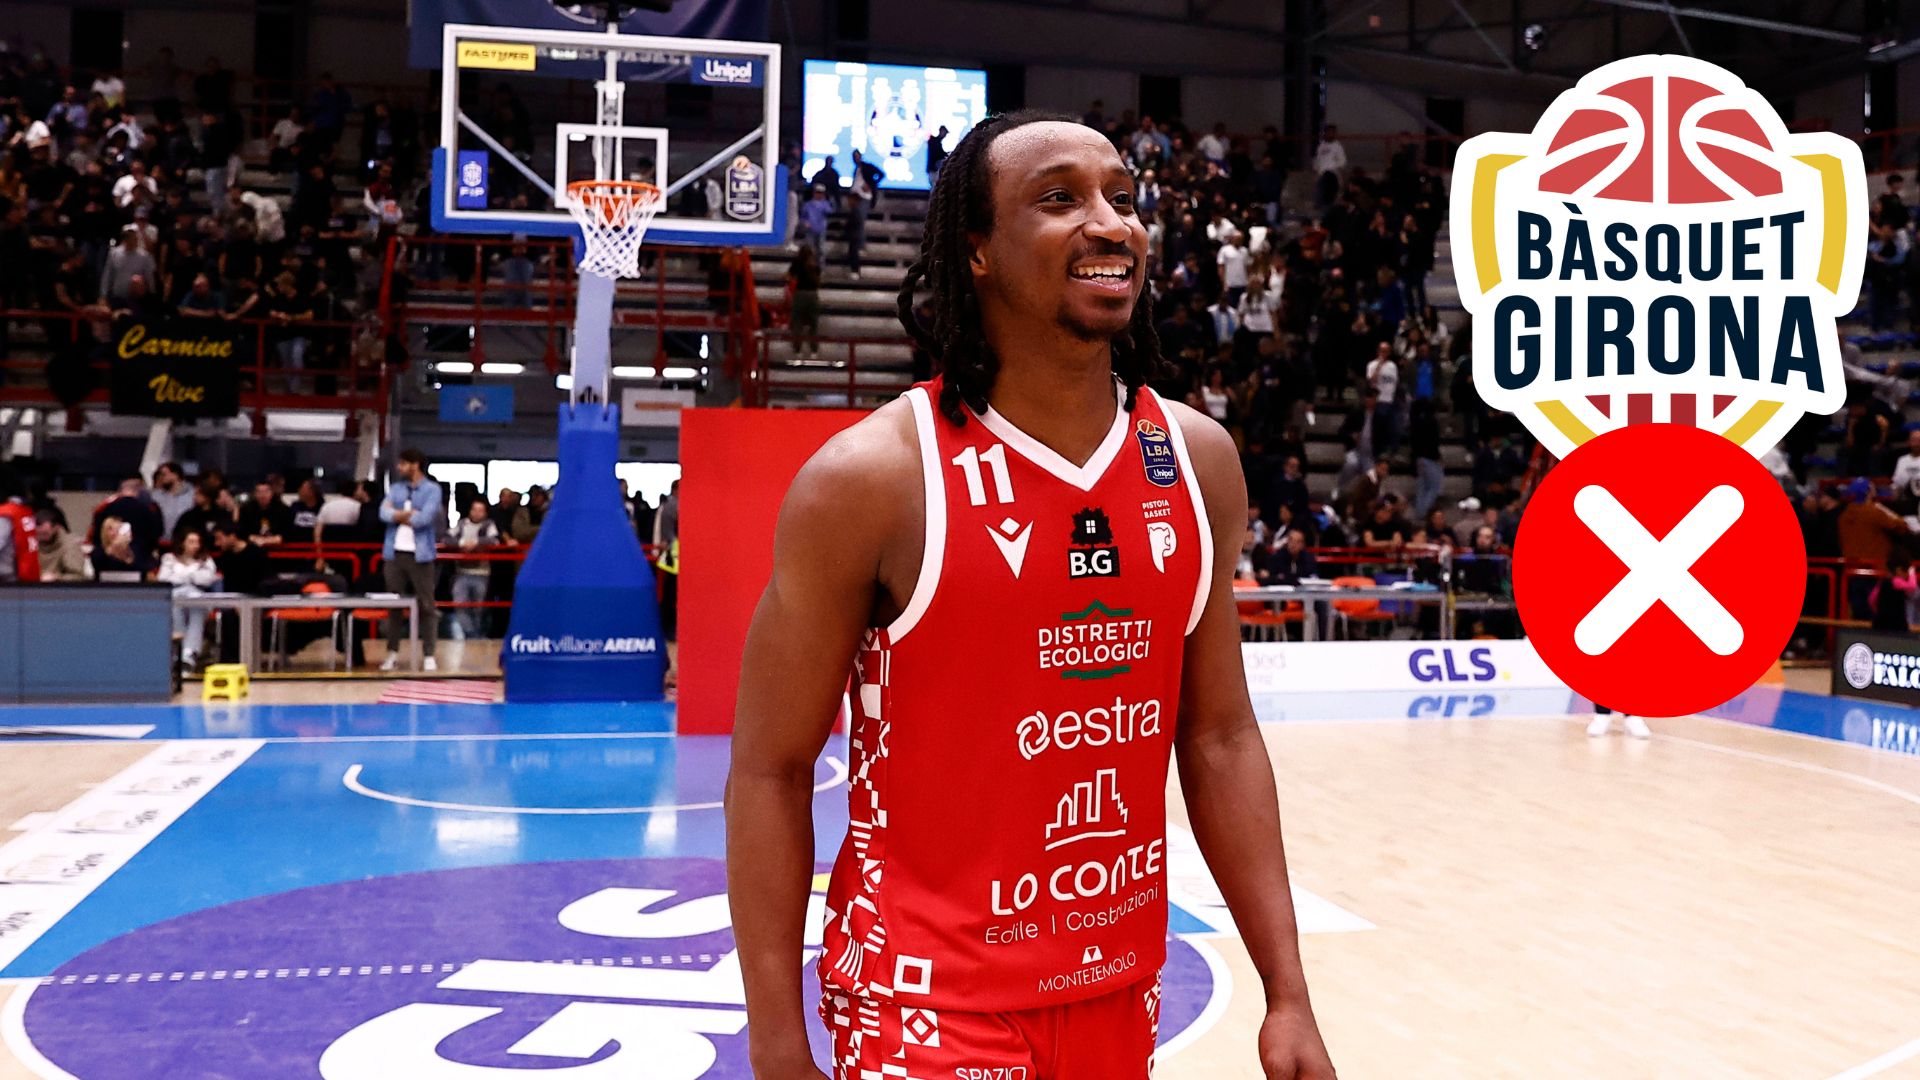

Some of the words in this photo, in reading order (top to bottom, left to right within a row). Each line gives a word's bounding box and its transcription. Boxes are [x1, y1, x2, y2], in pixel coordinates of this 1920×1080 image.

[705, 59, 752, 82] Unipol
[118, 324, 233, 359] Carmine
[148, 373, 205, 402] Vive
[1145, 445, 1171, 457] LBA
[952, 443, 1015, 506] 11
[1153, 468, 1175, 479] Unipol
[1142, 499, 1170, 510] PISTOIA
[1143, 508, 1171, 519] BASKET
[1069, 549, 1113, 577] B.G
[1038, 619, 1152, 647] DISTRETTI
[1039, 641, 1150, 669] ECOLOGICI
[1053, 696, 1161, 750] estra
[991, 872, 1038, 916] LO
[1049, 838, 1163, 901] CONTE
[985, 920, 1039, 944] Edile
[1066, 882, 1159, 932] Costruzioni
[1038, 951, 1137, 993] MONTEZEMOLO
